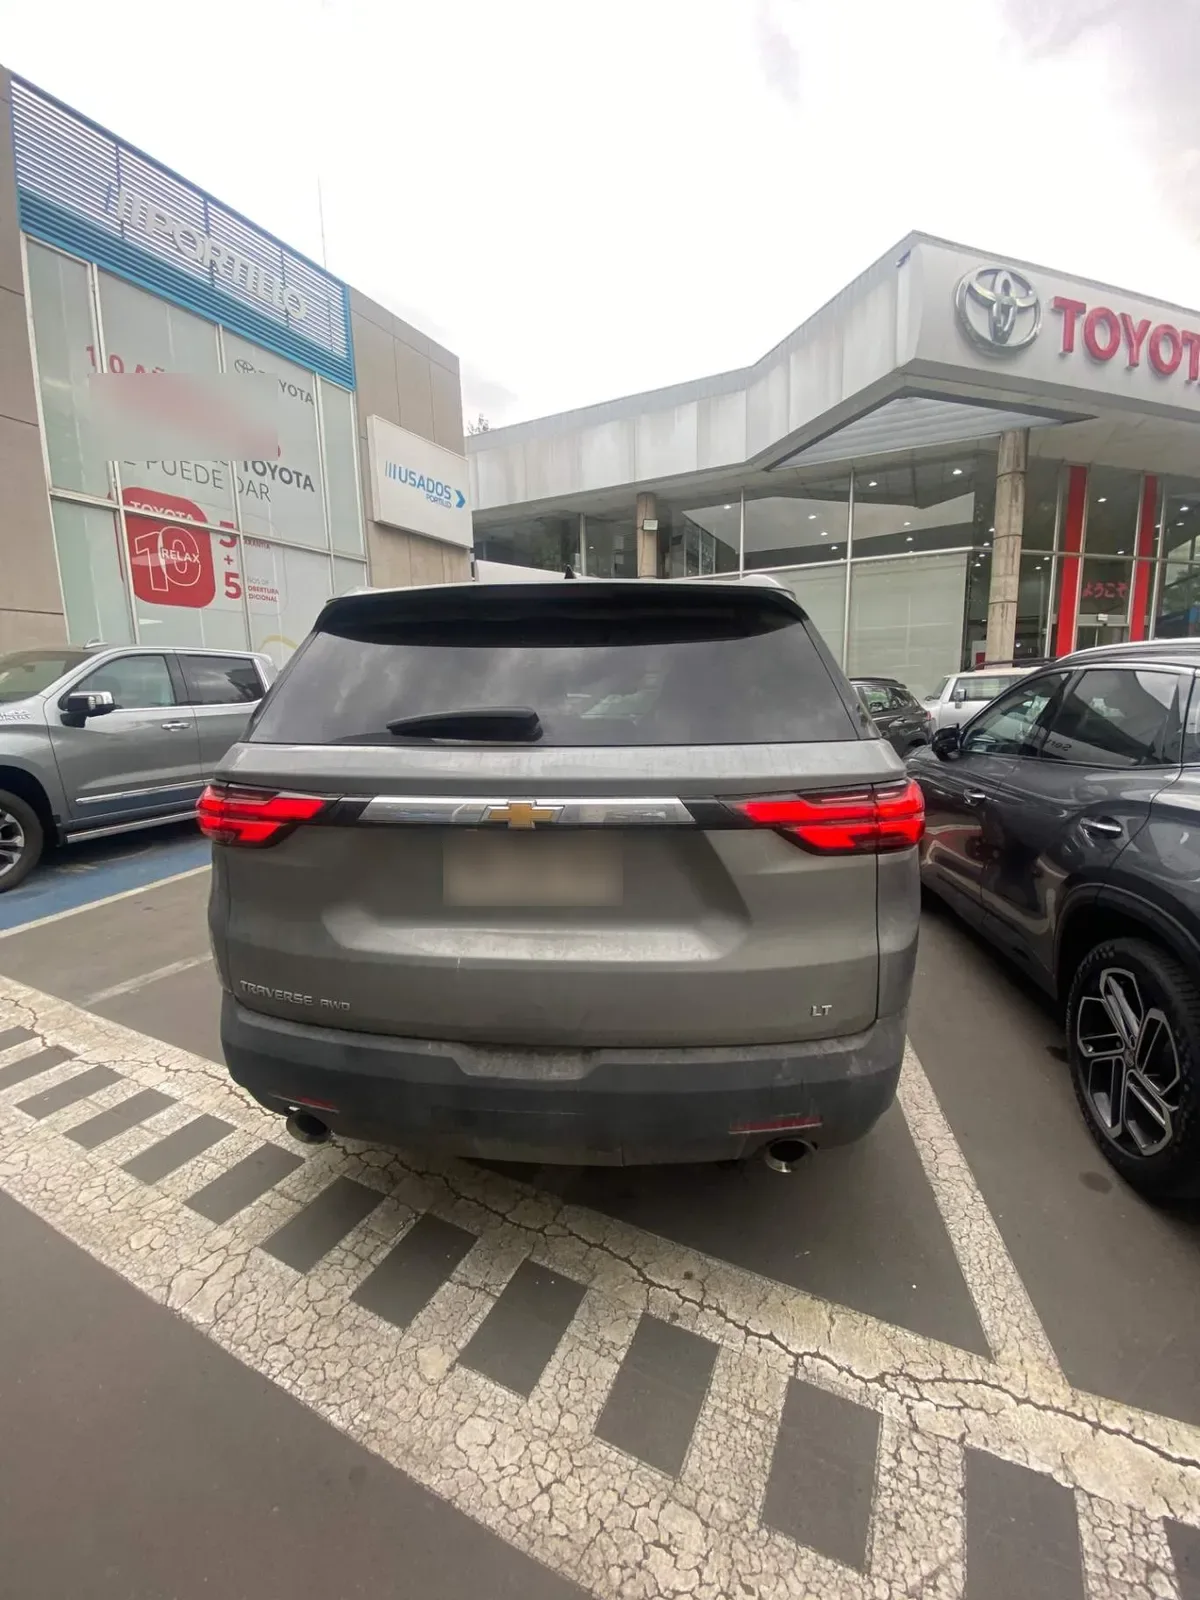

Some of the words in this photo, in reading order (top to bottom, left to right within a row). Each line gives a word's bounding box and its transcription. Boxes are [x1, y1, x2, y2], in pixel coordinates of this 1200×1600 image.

[141, 202, 309, 320] PORTILLO
[1053, 296, 1200, 382] TOYOT
[272, 377, 315, 406] YOTA
[398, 466, 452, 500] USADOS
[161, 547, 200, 564] RELAX
[225, 571, 242, 599] 5
[248, 585, 280, 595] OBERTURA
[248, 593, 278, 602] DICIONAL
[240, 979, 314, 1006] TRAVERSE
[320, 998, 351, 1011] AWD
[811, 1004, 833, 1017] LT
